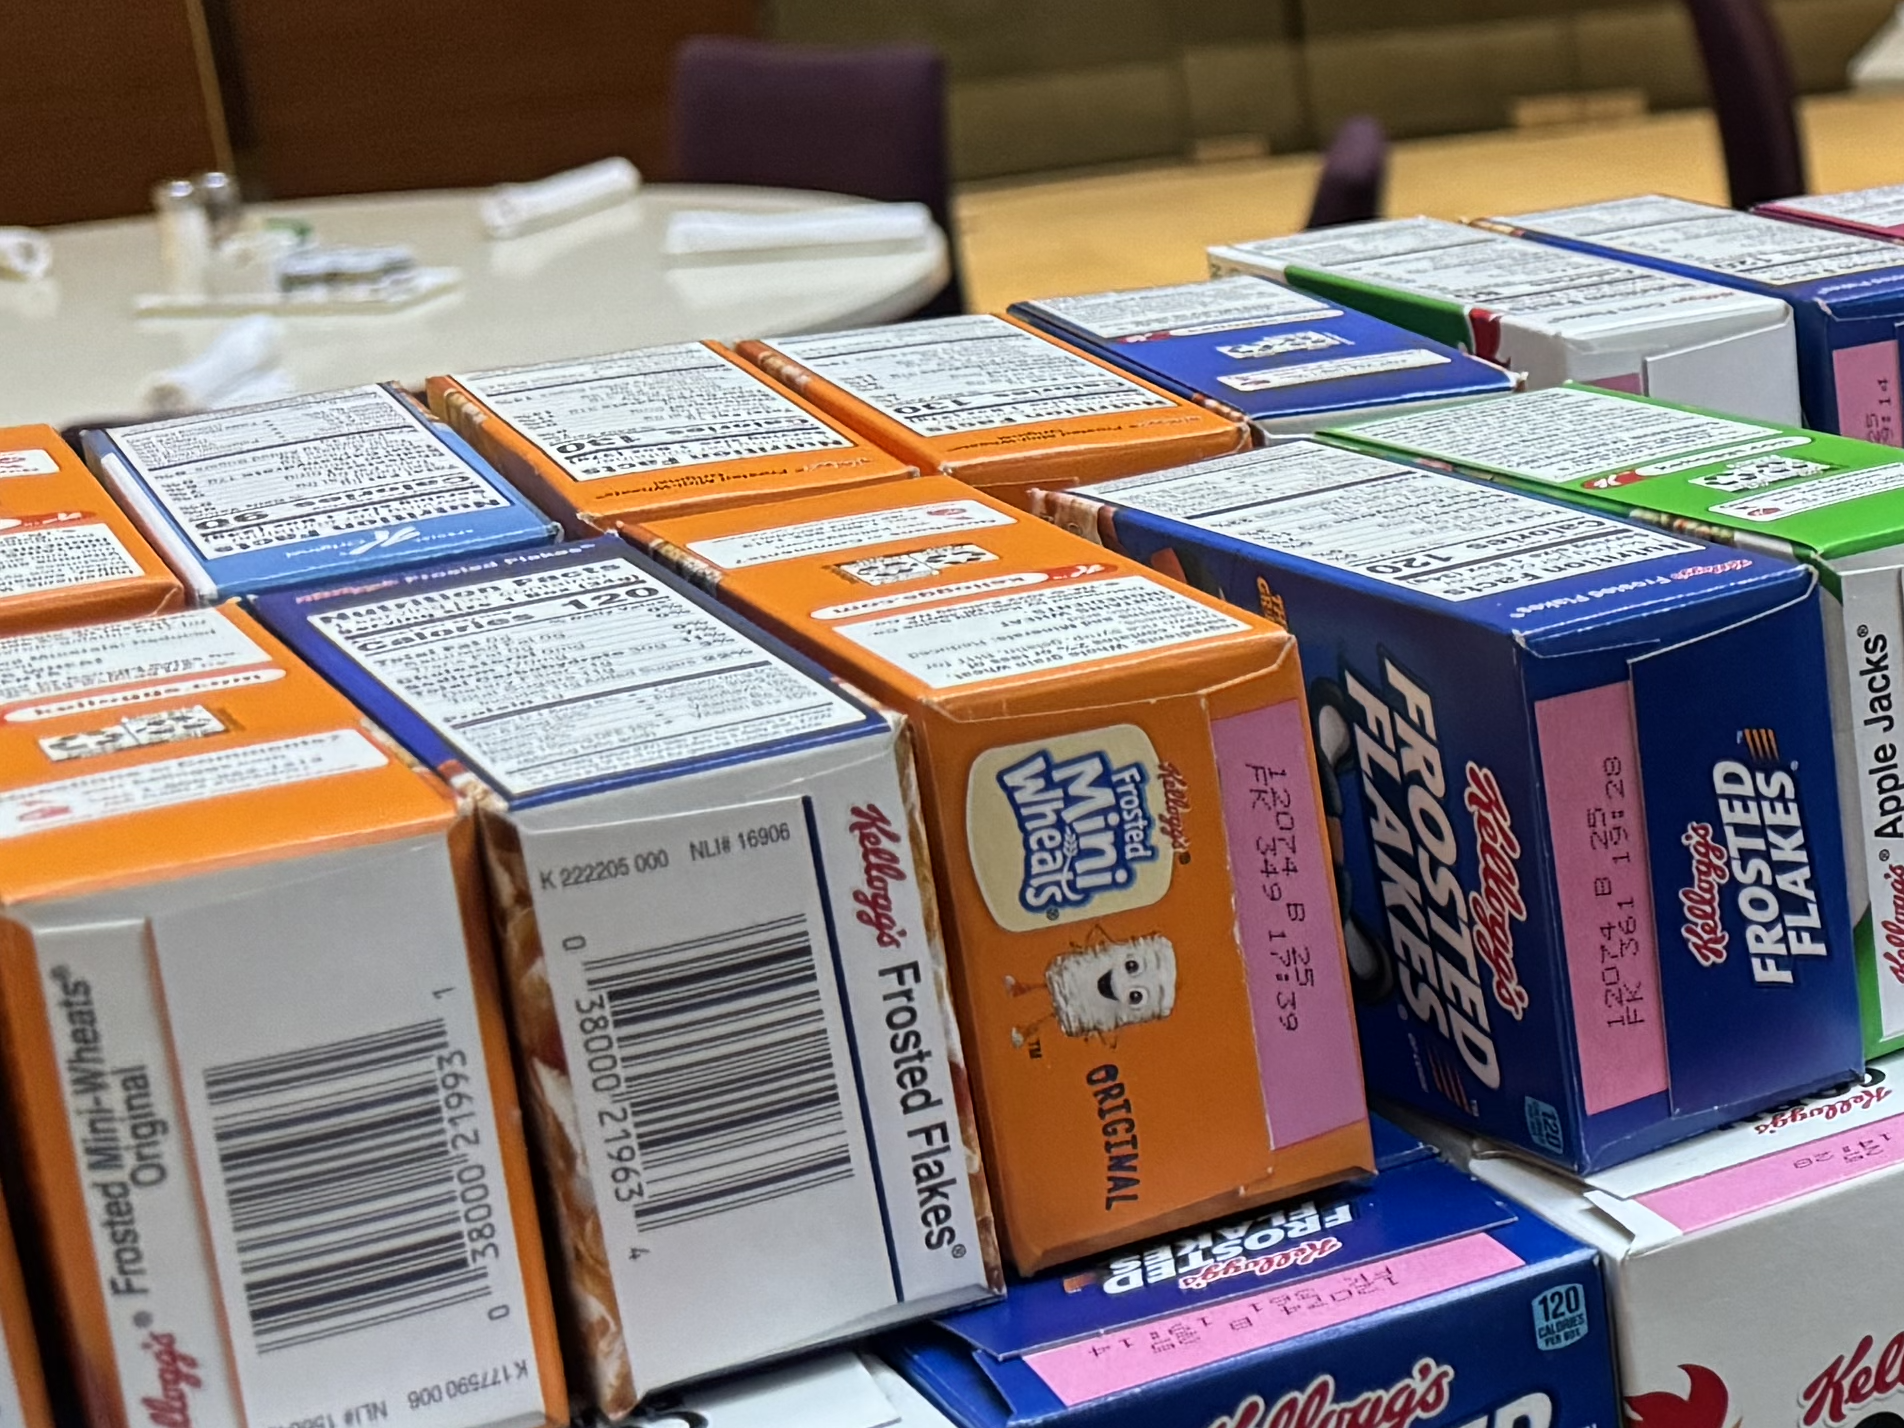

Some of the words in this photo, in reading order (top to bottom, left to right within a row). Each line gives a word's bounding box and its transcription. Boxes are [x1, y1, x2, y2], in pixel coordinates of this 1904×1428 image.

[192, 509, 270, 532] 90
[1356, 551, 1462, 576] 120
[1456, 518, 1615, 551] Calories
[1543, 542, 1688, 573] Nutrition
[317, 582, 504, 626] Nutrition
[511, 560, 624, 589] Facts
[352, 609, 538, 653] Calories
[558, 584, 663, 612] 120
[1431, 570, 1550, 597] Facts
[1000, 756, 1082, 907] Wheats
[1050, 750, 1128, 891] Mini
[1112, 766, 1152, 860] Frosted
[1158, 760, 1193, 855] Kellogg's
[1245, 762, 1270, 812] FK
[1268, 767, 1298, 878] 12074
[1586, 807, 1609, 852] 25
[1869, 743, 1904, 840] Apple
[539, 869, 555, 892] K
[560, 855, 631, 887] 222205
[633, 849, 670, 871] 000
[689, 833, 731, 862] NLI#
[736, 822, 792, 851] 16906
[1256, 837, 1283, 903] 349
[1345, 668, 1450, 1040] FLAKES
[1382, 657, 1500, 1090] FROSTED
[1465, 761, 1529, 1021] Kellogg's
[1680, 822, 1726, 967] Kellogg's
[1714, 760, 1794, 985] FROSTED
[1756, 771, 1829, 957] FLAKES
[1286, 902, 1306, 922] B
[1618, 897, 1639, 958] 361
[848, 804, 907, 949] Kellogg's
[878, 959, 945, 1116] Frosted
[1268, 930, 1299, 1033] 17:39
[1292, 945, 1314, 988] 25
[1599, 933, 1626, 1028] 12074
[1624, 978, 1646, 1027] FK
[114, 1063, 169, 1188] Original
[436, 1048, 482, 1153] 21993
[562, 935, 586, 952] 0
[574, 996, 619, 1095] 38000
[598, 1106, 644, 1203] 21963
[627, 1246, 649, 1261] 4
[1085, 1063, 1140, 1212] ORIGINAL
[89, 1178, 151, 1298] Frosted
[458, 1163, 500, 1261] 38000
[1103, 1203, 1353, 1295] FROSTED
[1538, 1291, 1581, 1321] 120
[1540, 1314, 1586, 1341] CALORIES
